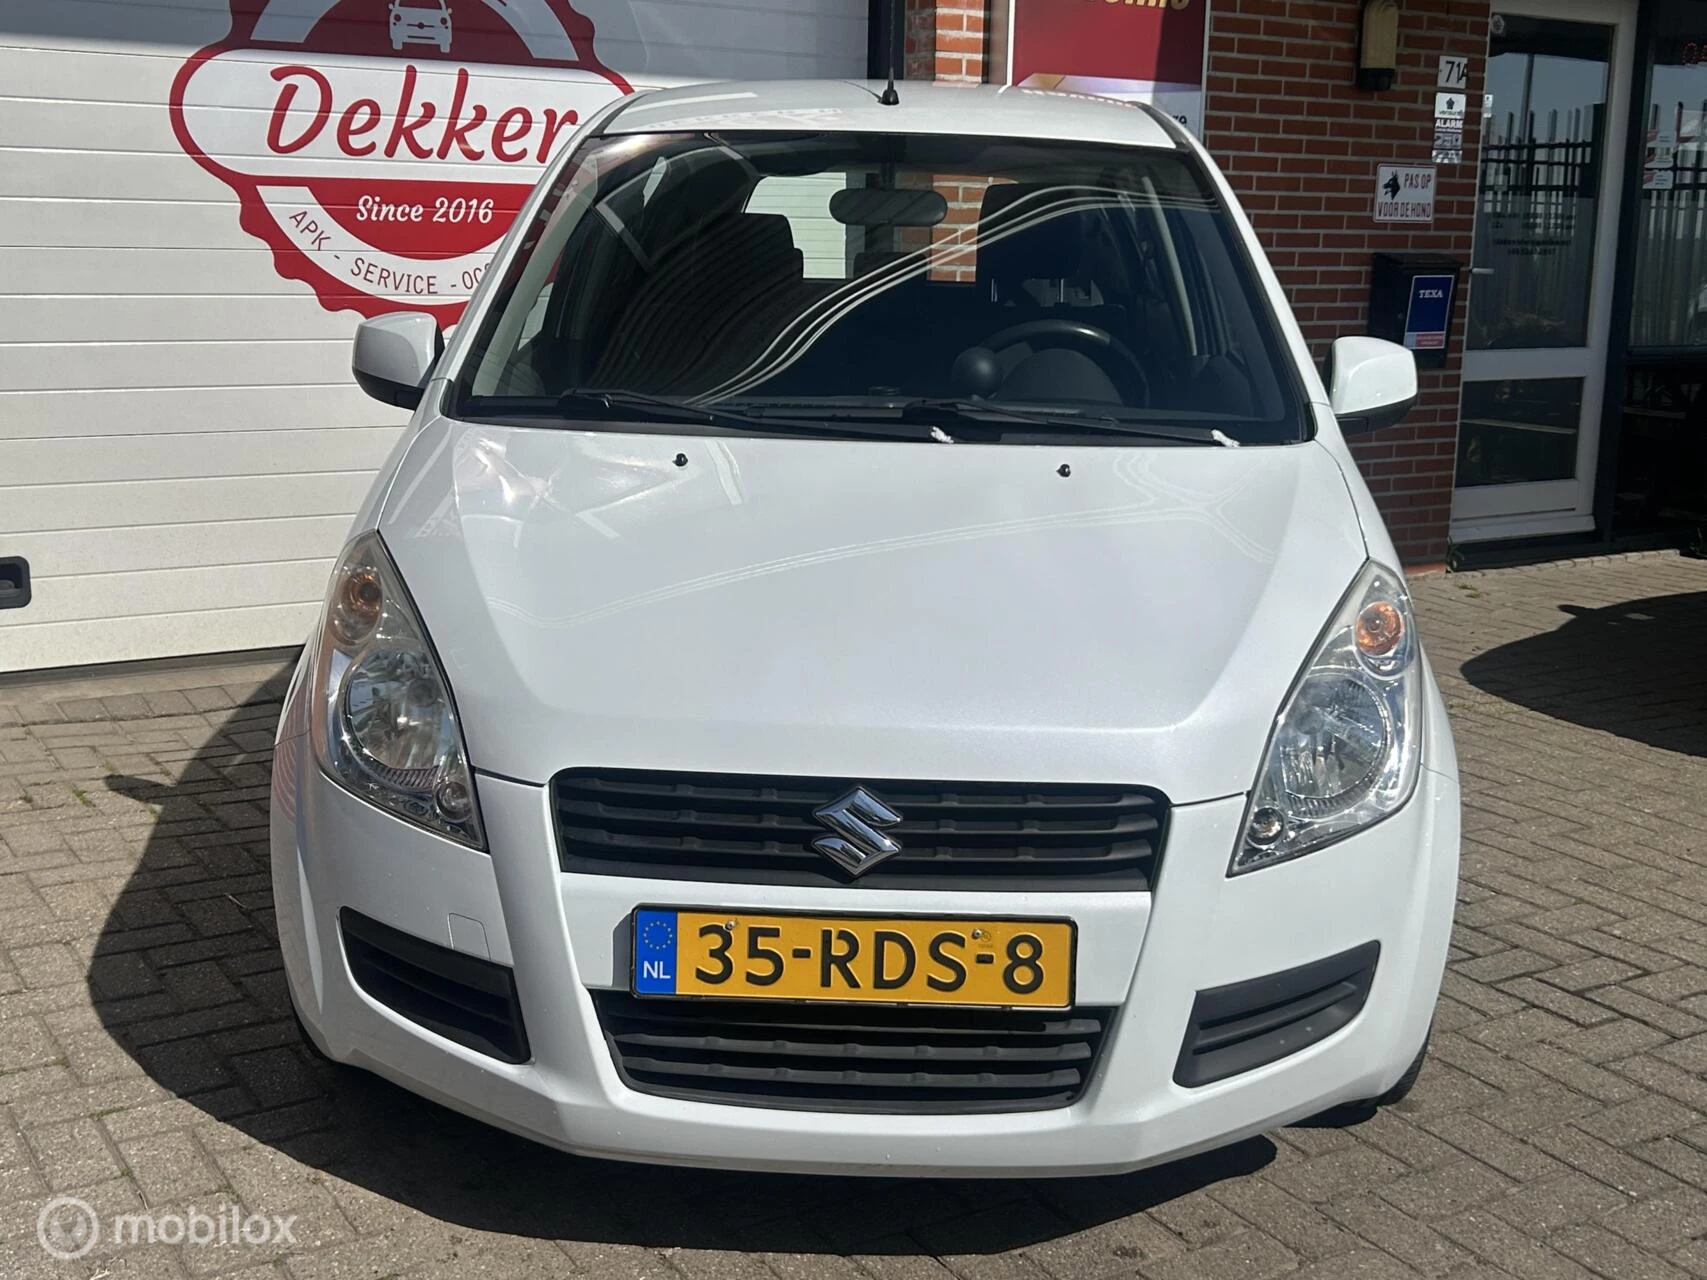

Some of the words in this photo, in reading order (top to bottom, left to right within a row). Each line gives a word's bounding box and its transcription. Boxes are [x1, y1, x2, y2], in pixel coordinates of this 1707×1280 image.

[267, 64, 579, 163] Dekker
[1435, 118, 1463, 129] ALARM
[1404, 173, 1419, 189] PAS
[1420, 174, 1431, 189] OP
[356, 195, 424, 222] Since
[432, 197, 494, 224] 2016
[1377, 201, 1399, 217] VOOR
[1399, 202, 1410, 218] DE
[1410, 202, 1432, 218] HOND
[289, 210, 331, 251] APK
[351, 257, 438, 294] SERVICE
[1419, 289, 1443, 298] TEXA
[695, 921, 1045, 995] 35-RDS-8
[643, 960, 671, 980] NL
